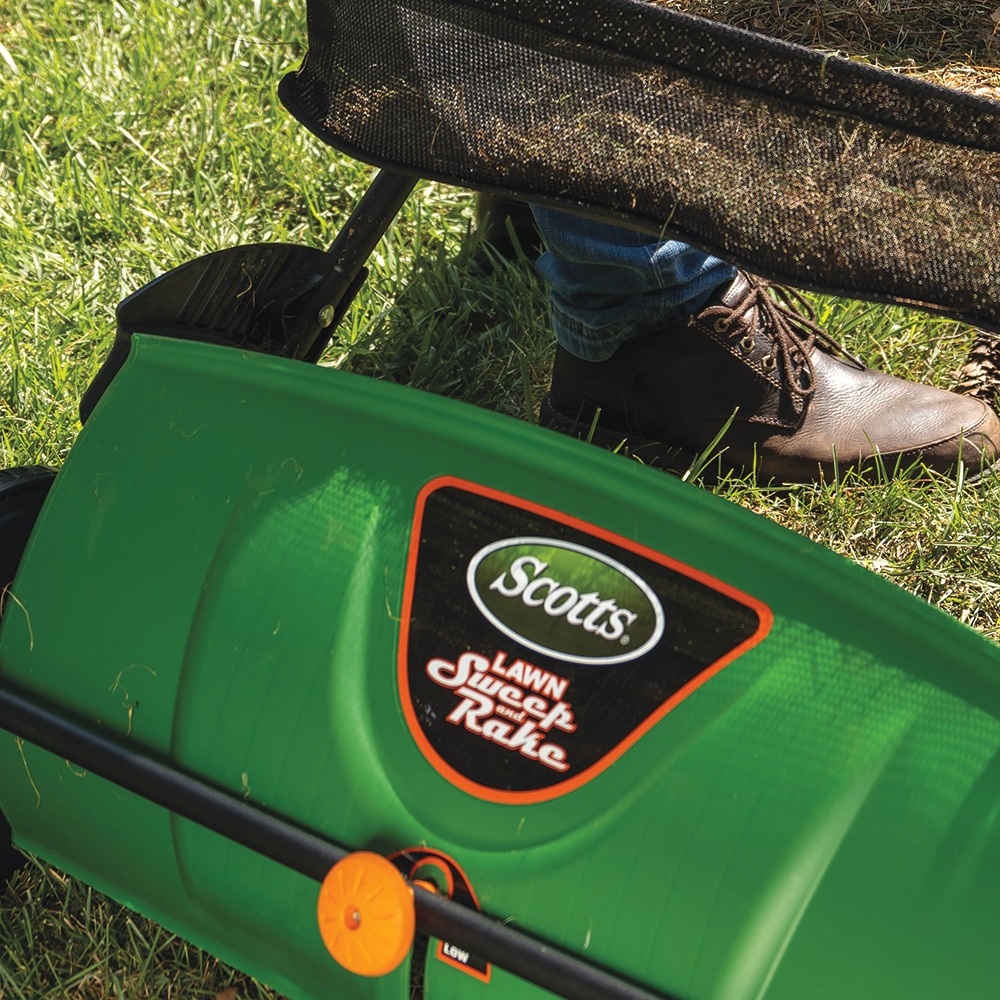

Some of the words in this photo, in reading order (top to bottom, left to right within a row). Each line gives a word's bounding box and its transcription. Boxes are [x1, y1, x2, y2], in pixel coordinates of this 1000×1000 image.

[428, 652, 576, 732] Sweep
[490, 651, 570, 701] LAWN
[447, 686, 570, 771] Rake
[495, 704, 527, 722] and
